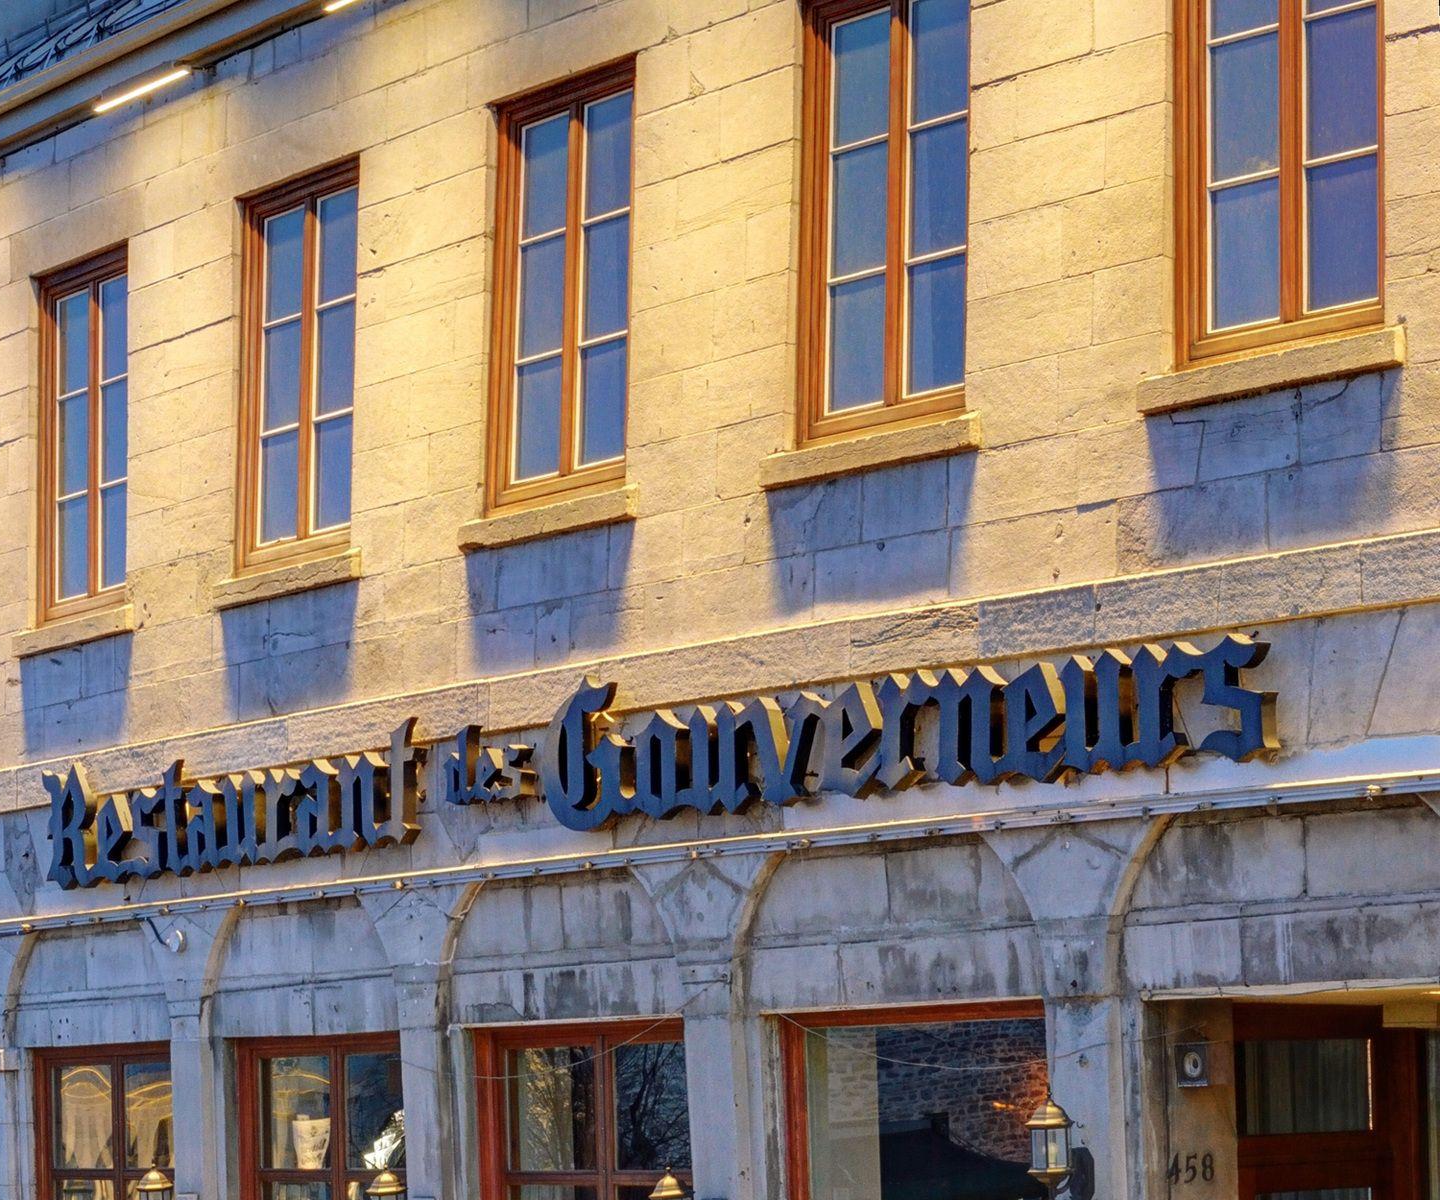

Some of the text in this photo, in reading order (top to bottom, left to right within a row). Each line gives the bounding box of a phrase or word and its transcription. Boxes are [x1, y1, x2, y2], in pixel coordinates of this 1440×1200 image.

[41, 633, 1280, 890] Restaurant des Gouverneurs
[1166, 1152, 1215, 1185] 458
